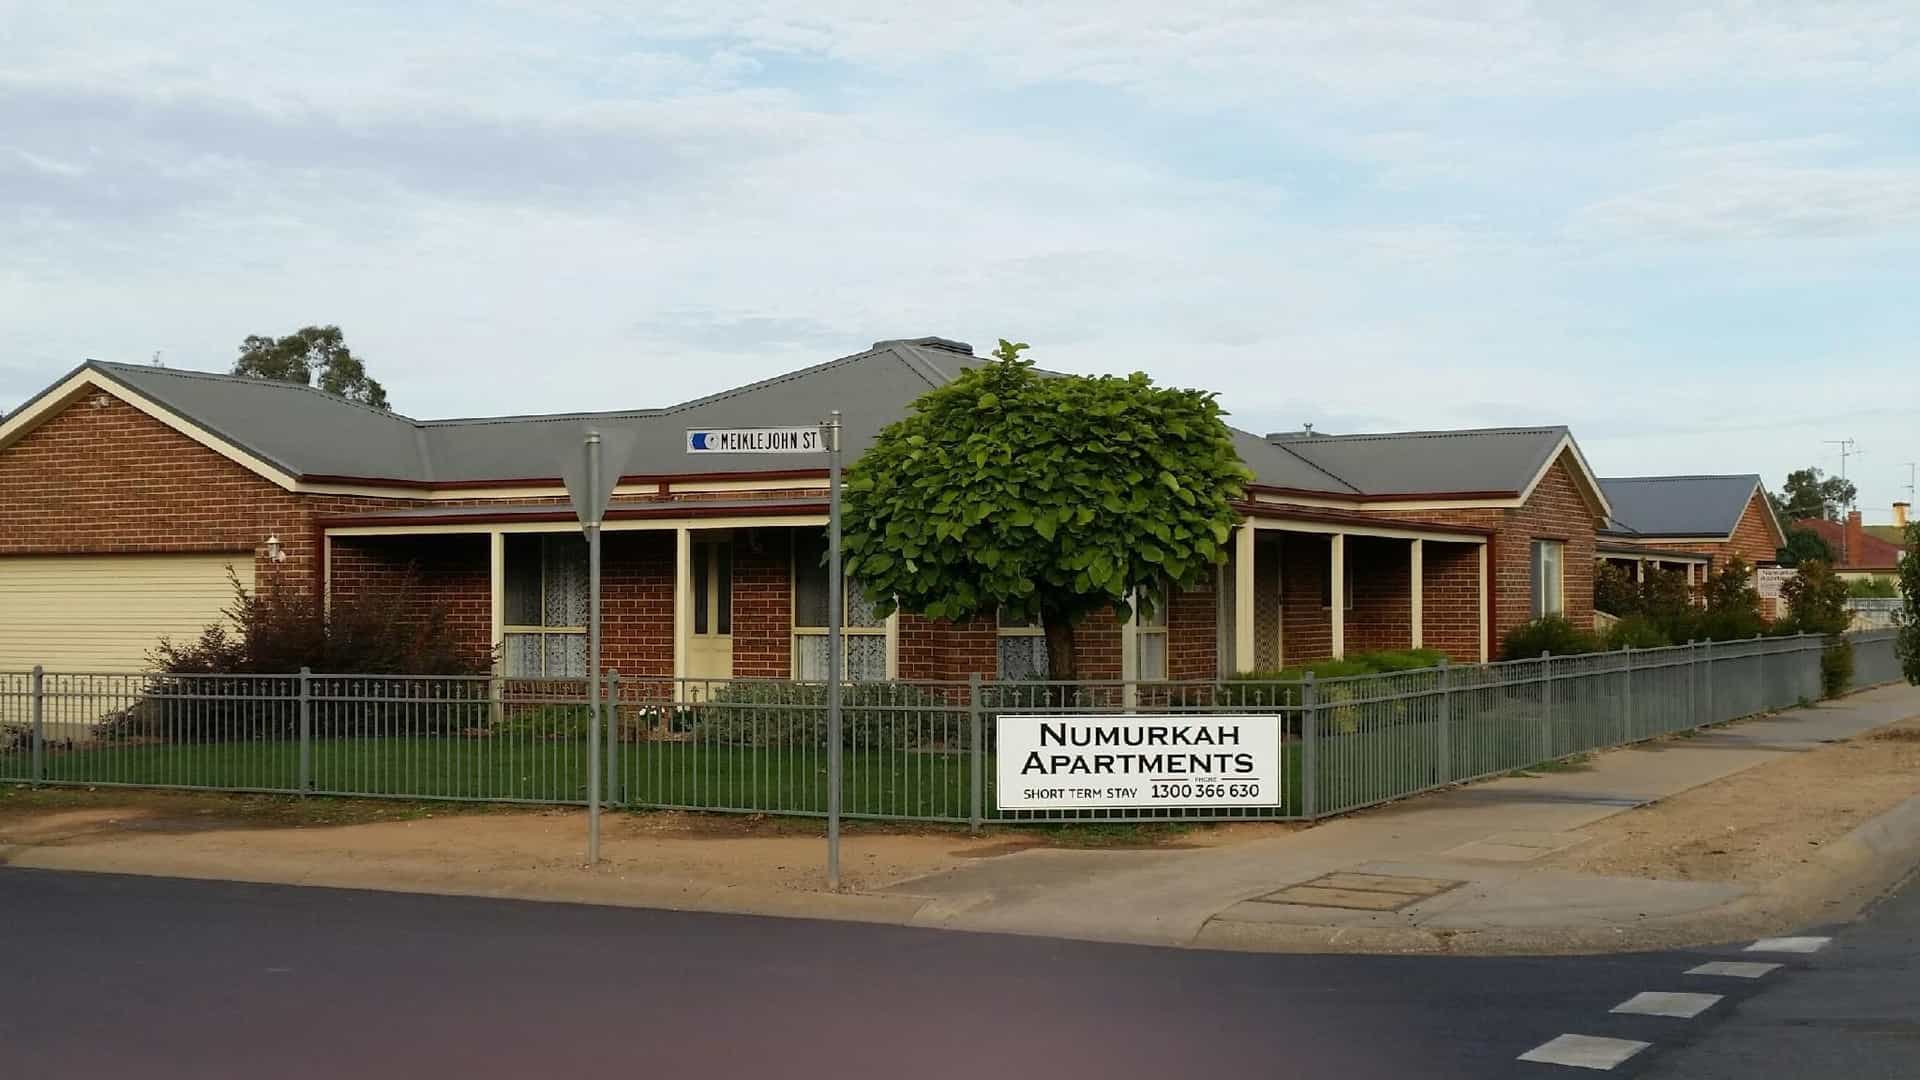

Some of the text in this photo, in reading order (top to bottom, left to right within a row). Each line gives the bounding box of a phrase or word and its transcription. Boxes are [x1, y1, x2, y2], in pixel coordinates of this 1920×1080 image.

[721, 431, 817, 449] MEIKLEJOHN ST
[1040, 723, 1239, 747] NUMURKAH
[1021, 751, 1254, 775] APARTMENTS
[1023, 783, 1260, 799] SHORT TERM STAY 1300 366 630
